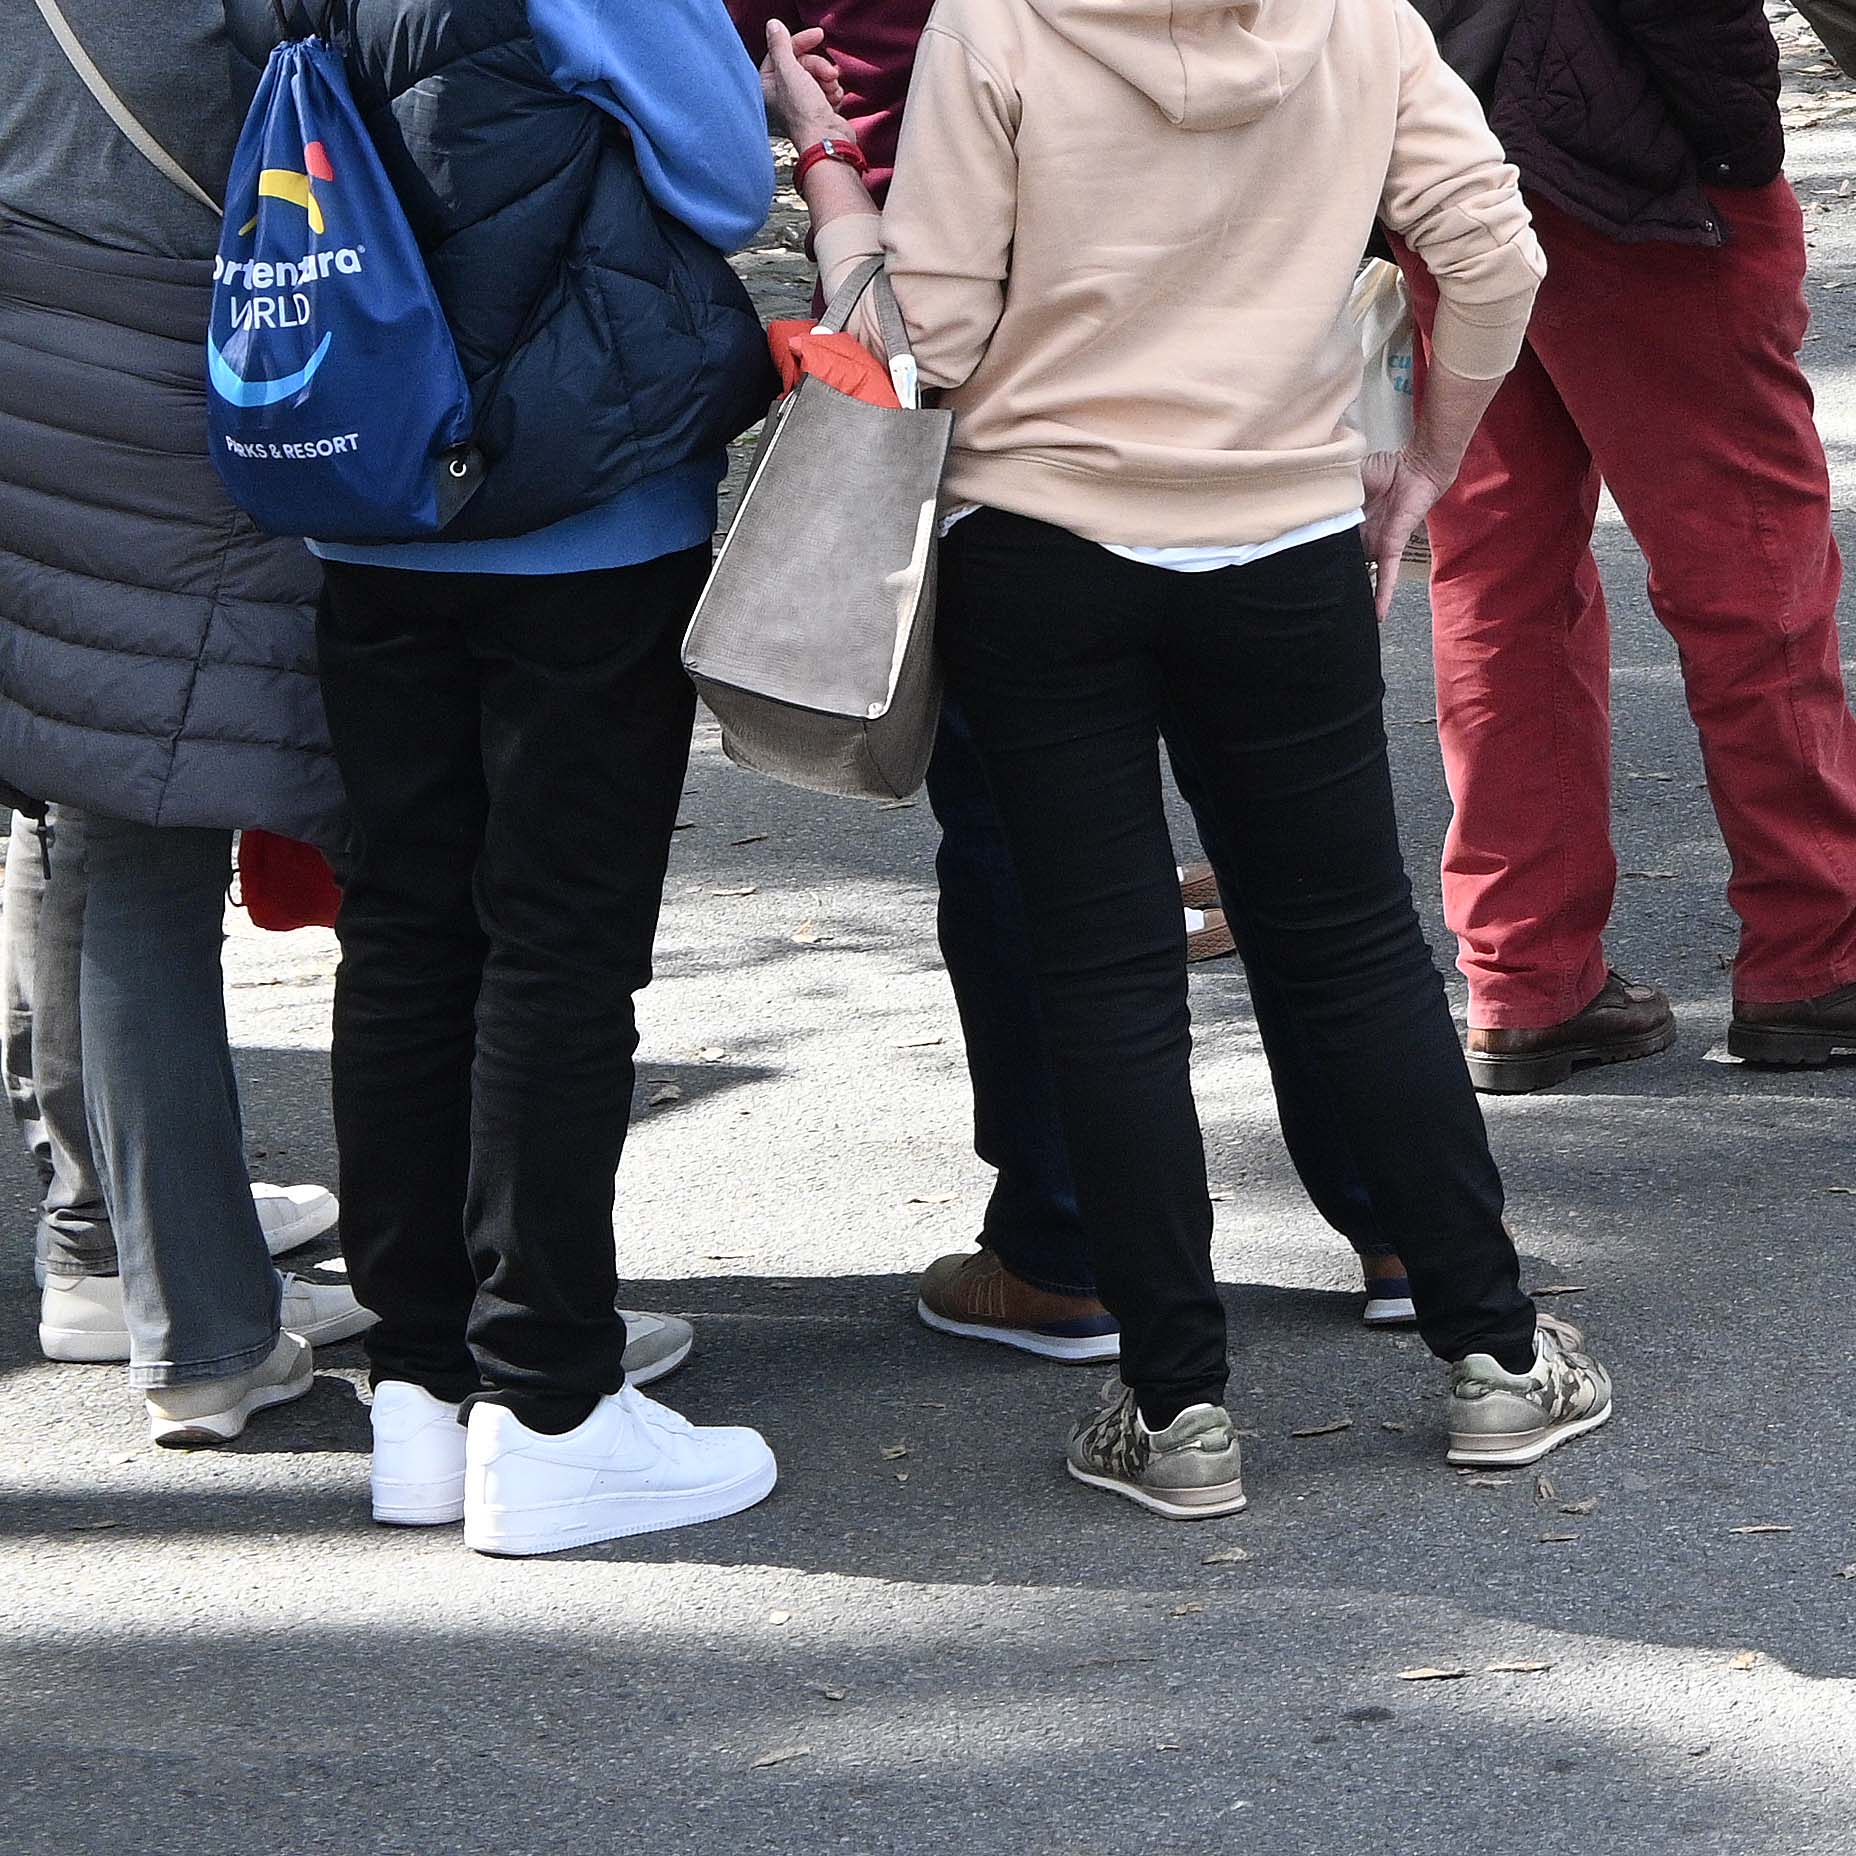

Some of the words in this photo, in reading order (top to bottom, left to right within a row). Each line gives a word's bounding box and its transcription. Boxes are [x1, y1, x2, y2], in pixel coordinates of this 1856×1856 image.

[230, 293, 311, 331] WRLD
[268, 443, 283, 459] &
[282, 433, 359, 459] RESORT
